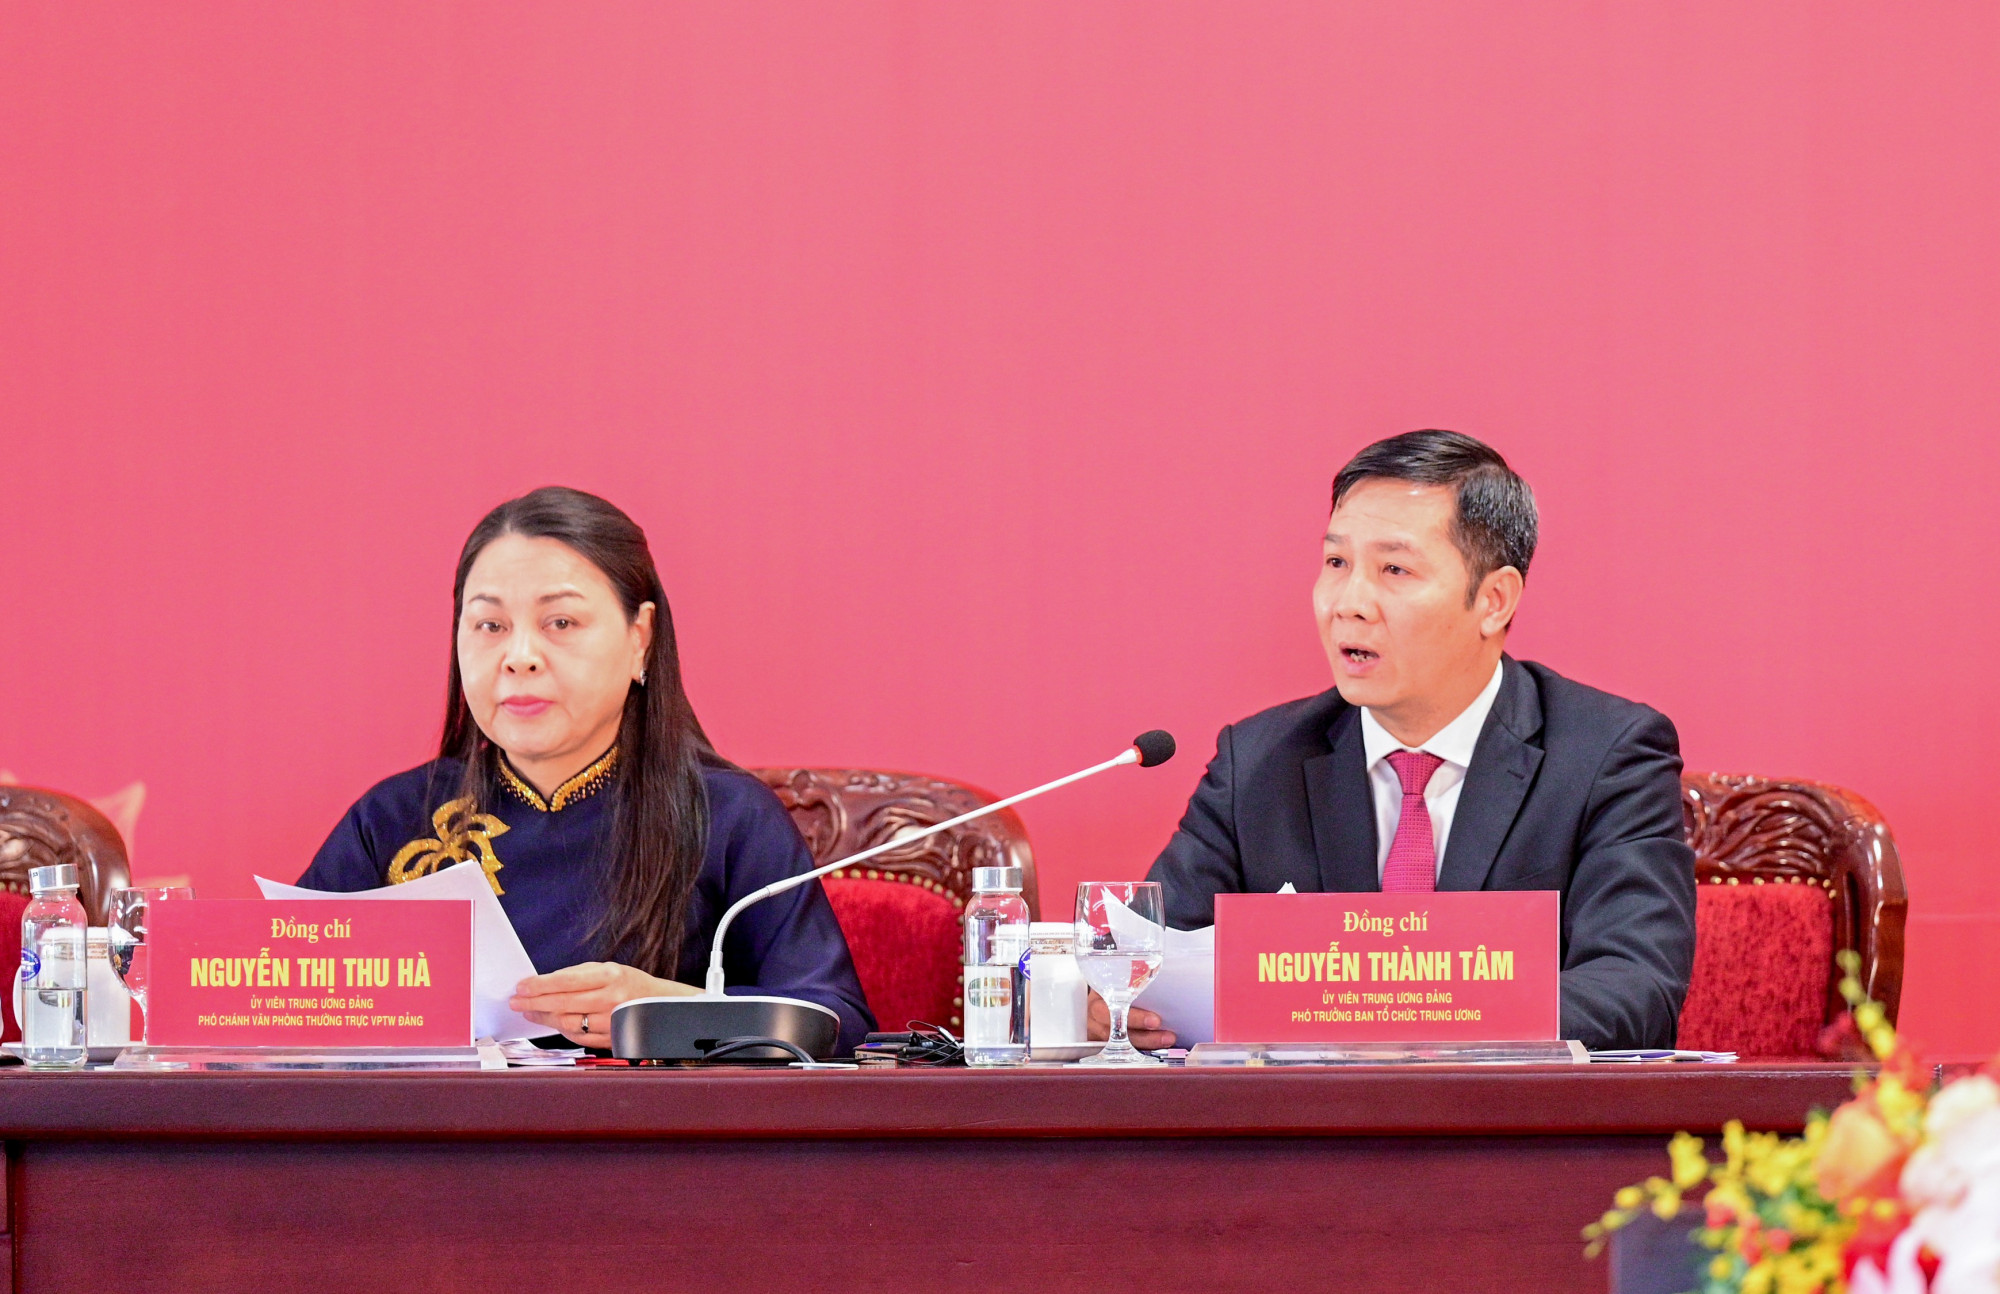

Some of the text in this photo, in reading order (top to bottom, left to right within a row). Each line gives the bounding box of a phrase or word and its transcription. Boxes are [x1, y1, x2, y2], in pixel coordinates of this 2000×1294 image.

[270, 916, 352, 943] Đồng chí
[1343, 909, 1429, 937] Đồng chí
[190, 947, 432, 994] NGUYỄN THỊ THU HÀ
[1258, 941, 1514, 983] NGUYỄN THÀNH TÂM
[250, 994, 374, 1009] ỦY VIÊN TRUNG ƯƠNG ĐẢNG
[1322, 988, 1453, 1005] ỦY VIÊN TRUNG ƯƠNG ĐẢNG
[198, 1011, 424, 1028] PHÓ CHÁNH VĂN PHÒNG THƯỜNG TRỰC VPTW ĐẢNG
[1291, 1004, 1482, 1022] PHÓ TRƯỞNG BAN TỔ CHỨC TRUNG ƯƠNG
